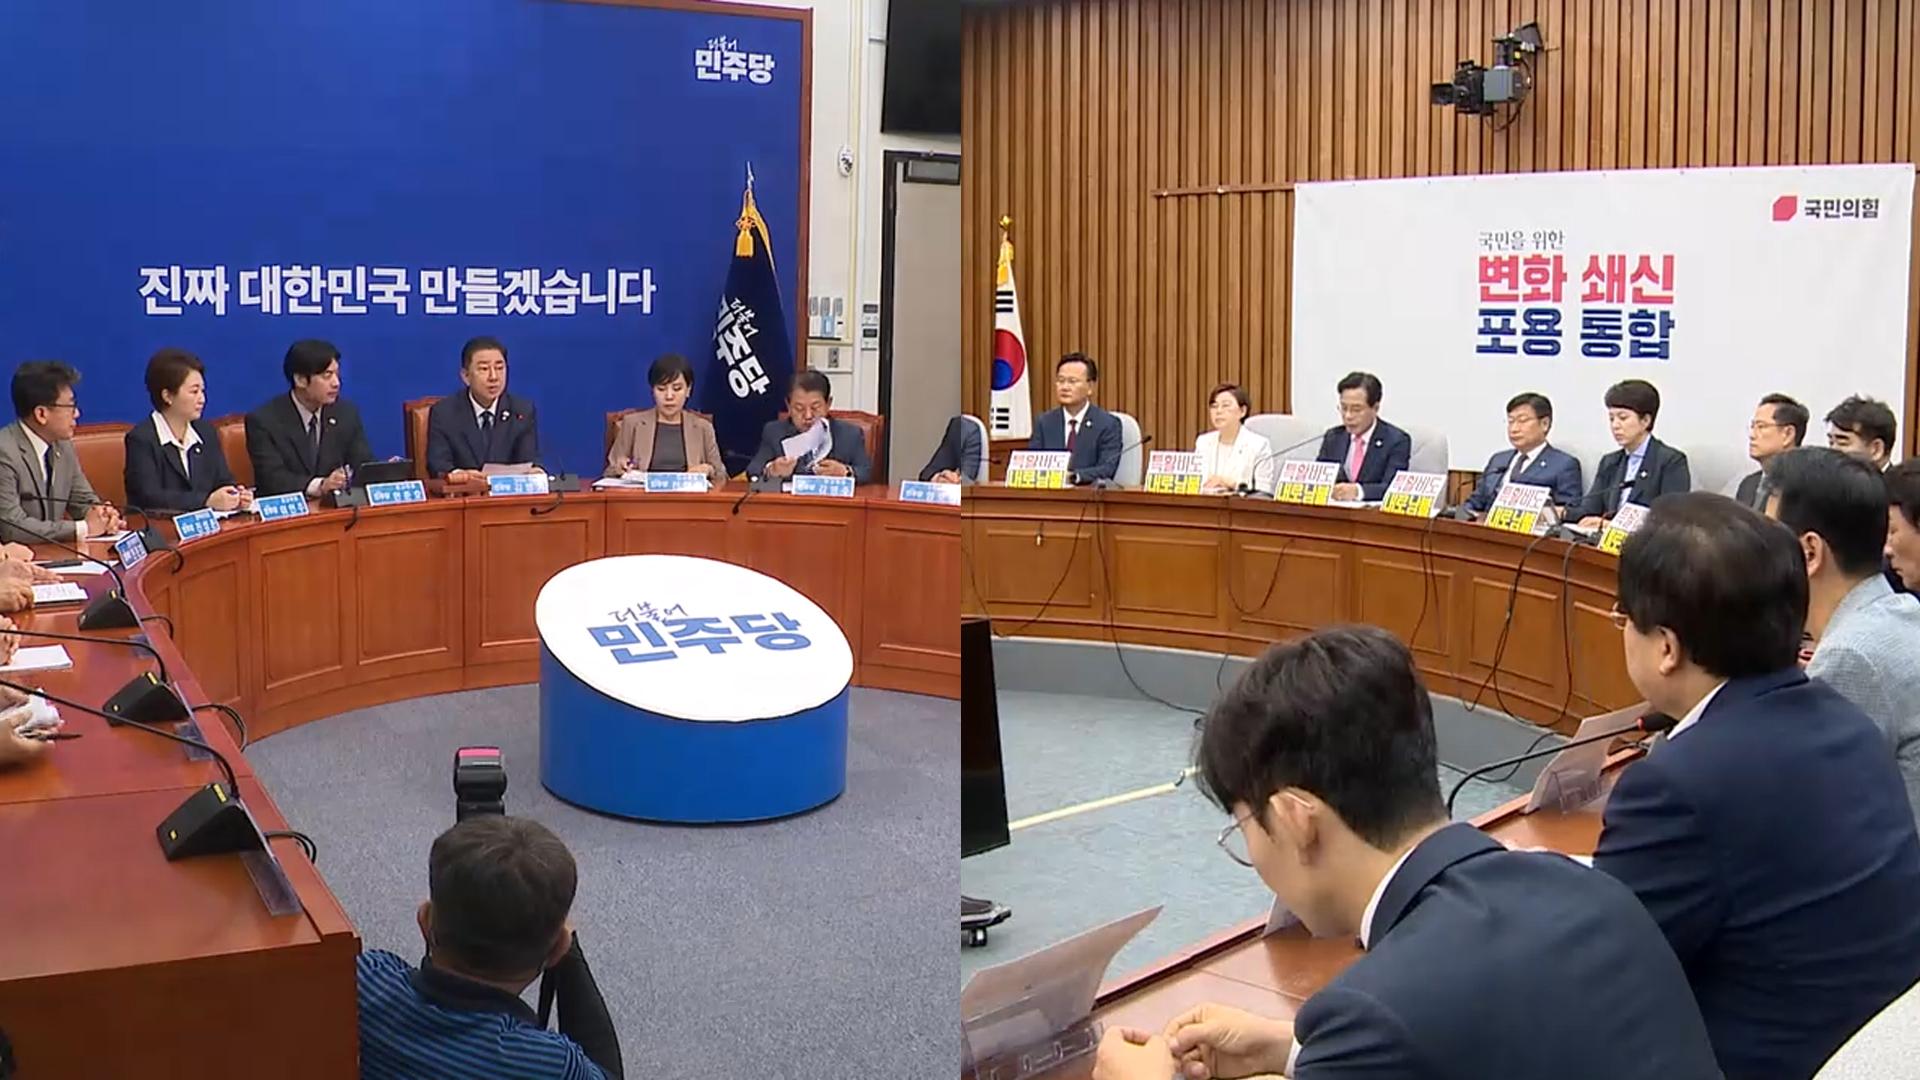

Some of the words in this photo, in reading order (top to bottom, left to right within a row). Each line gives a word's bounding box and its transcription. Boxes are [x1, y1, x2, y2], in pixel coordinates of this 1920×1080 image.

[695, 49, 775, 84] 민주당
[1804, 198, 1879, 219] 국민의힘
[1478, 231, 1525, 250] 국민을
[1531, 231, 1564, 250] 위한
[138, 265, 229, 315] 진짜
[239, 265, 411, 315] 대한민국
[419, 267, 656, 315] 만들겠습니다
[1478, 254, 1567, 303] 변화
[1581, 254, 1675, 304] 쇄신
[1476, 307, 1563, 357] 포용
[1580, 308, 1675, 360] 통합
[1276, 482, 1331, 505] 내로남불
[608, 601, 688, 624] 더불어
[587, 612, 812, 664] 민주당
